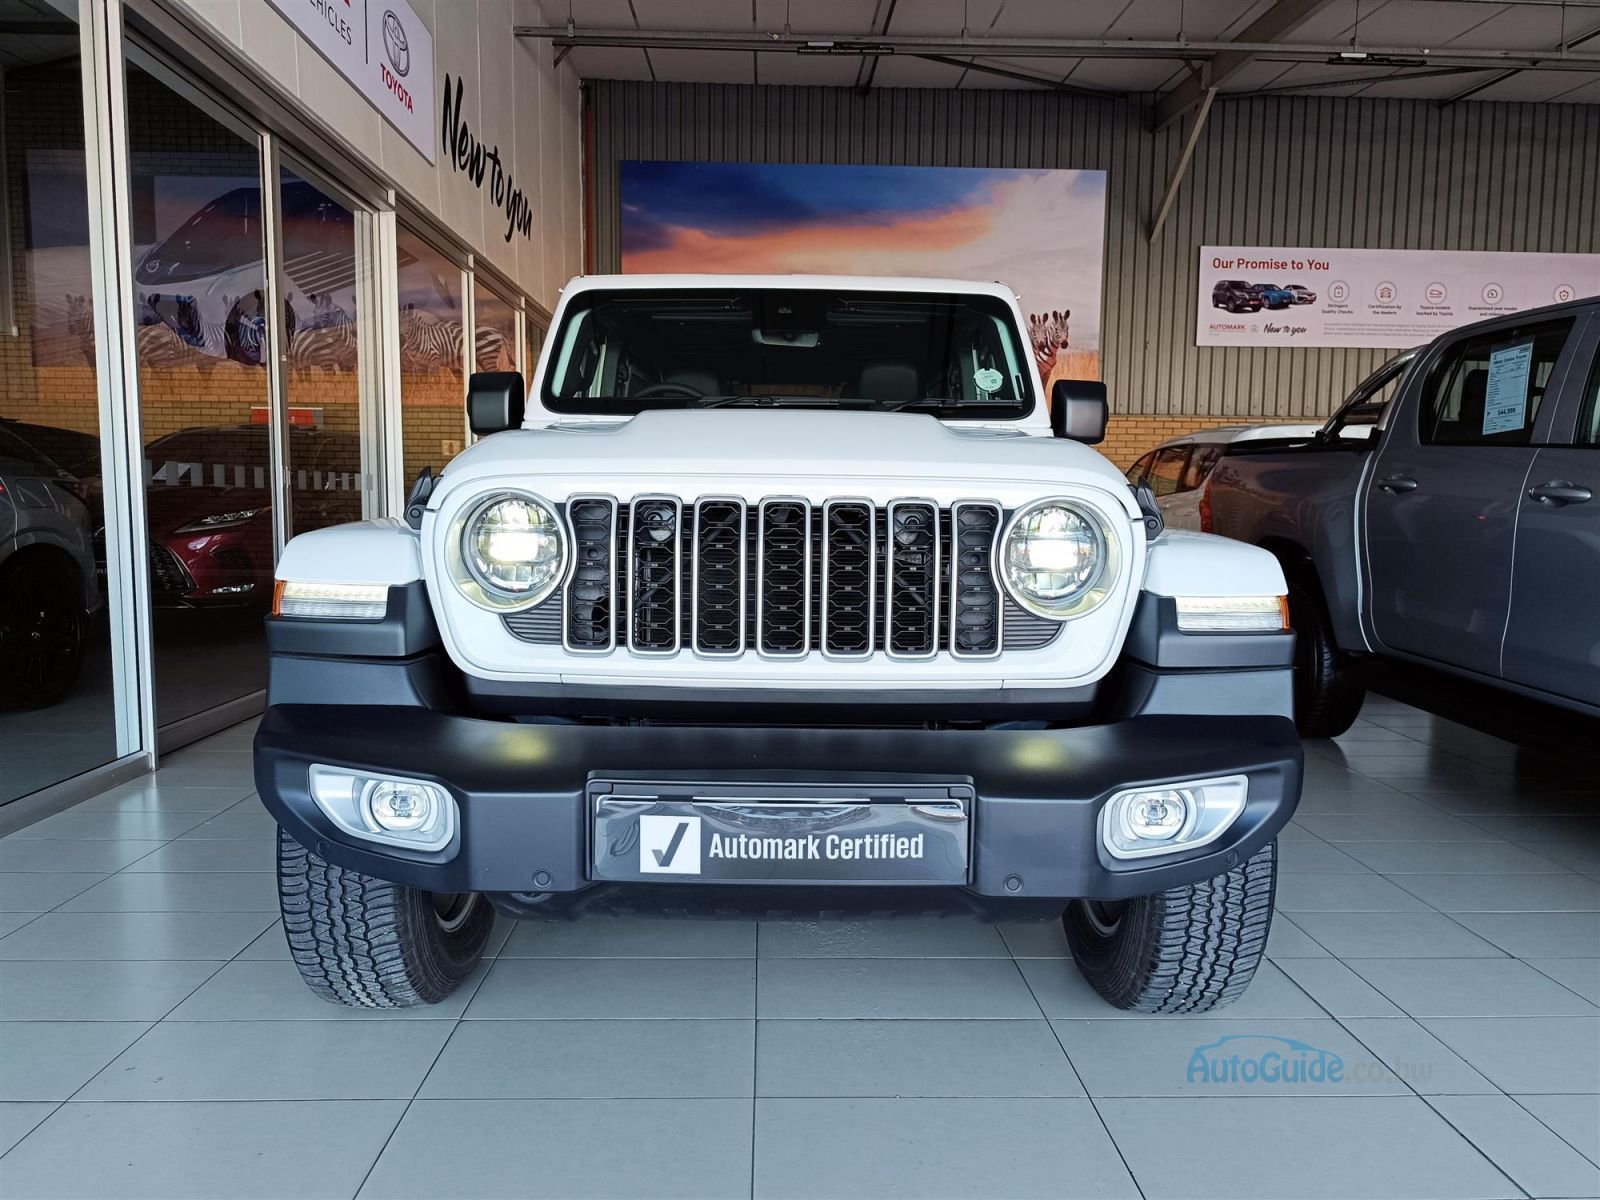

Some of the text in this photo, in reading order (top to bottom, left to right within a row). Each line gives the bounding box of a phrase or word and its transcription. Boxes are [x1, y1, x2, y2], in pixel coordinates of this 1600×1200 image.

[380, 63, 414, 114] TOYOTA
[442, 72, 533, 243] New to you
[1212, 257, 1330, 270] Our Promise to You
[1263, 322, 1307, 337] New to you
[708, 832, 924, 860] Automark Certified
